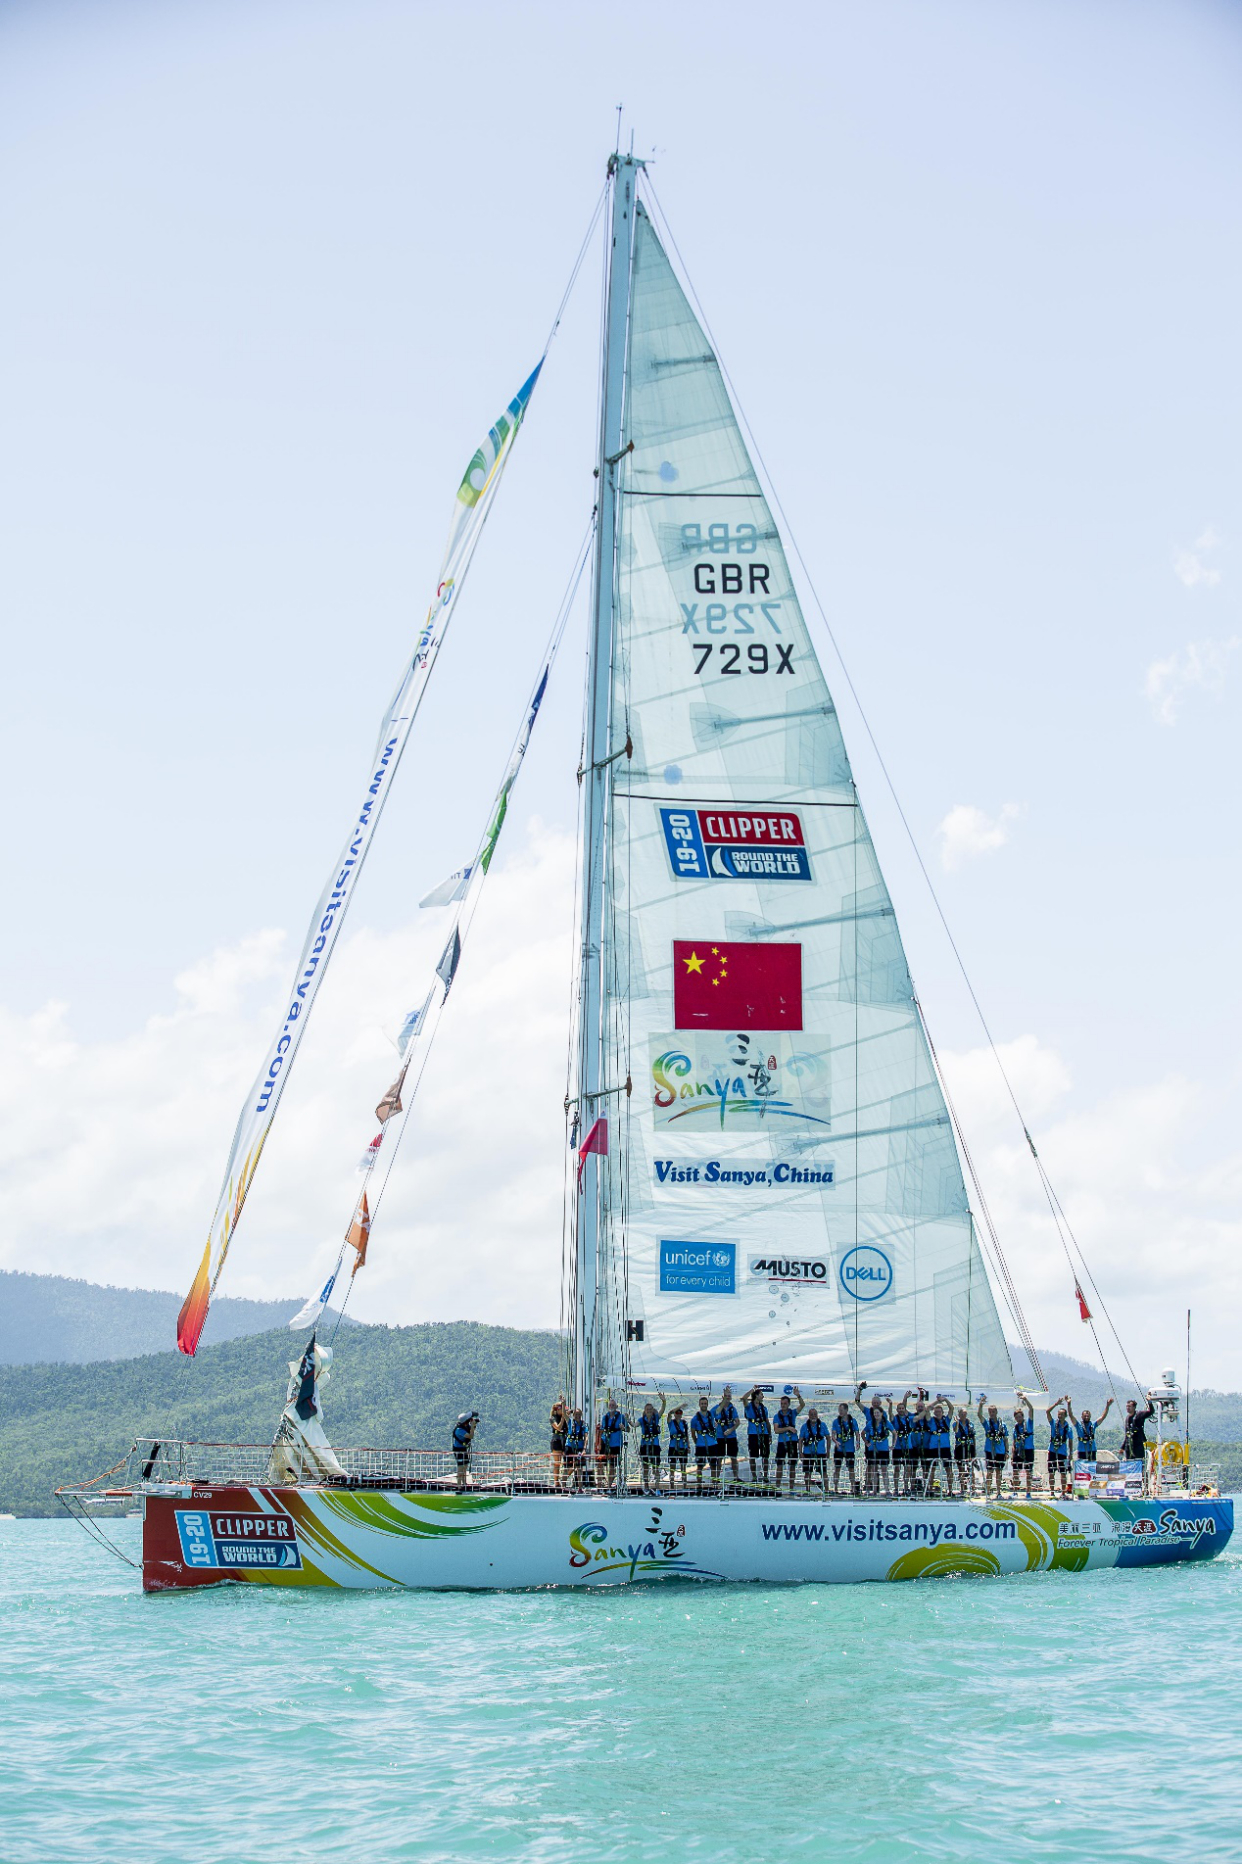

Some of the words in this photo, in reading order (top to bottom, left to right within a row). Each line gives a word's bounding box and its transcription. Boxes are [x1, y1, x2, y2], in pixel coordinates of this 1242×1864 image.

[694, 563, 770, 594] GBR
[693, 644, 795, 674] 729X
[706, 816, 796, 839] CLIPPER
[669, 814, 700, 872] 19-20
[732, 852, 774, 861] ROUND
[775, 853, 798, 862] THE
[733, 861, 800, 874] WORLD
[652, 1051, 748, 1131] Sanya
[654, 1161, 700, 1182] Visit
[665, 1250, 712, 1266] unicef
[754, 1259, 827, 1278] MUSTO
[666, 1276, 680, 1285] for
[680, 1277, 707, 1288] every
[708, 1276, 731, 1287] child
[846, 1266, 886, 1281] DELL
[216, 1518, 289, 1537] CLIPPER
[762, 1519, 1015, 1545] www.visitsanya.com
[1159, 1509, 1216, 1549] Sanya
[183, 1514, 211, 1564] 19-20
[1057, 1538, 1096, 1548] Forever
[1099, 1537, 1137, 1548] Tropical
[1139, 1535, 1180, 1546] Paradise
[223, 1552, 277, 1563] WORLD
[569, 1522, 656, 1580] Sanya
